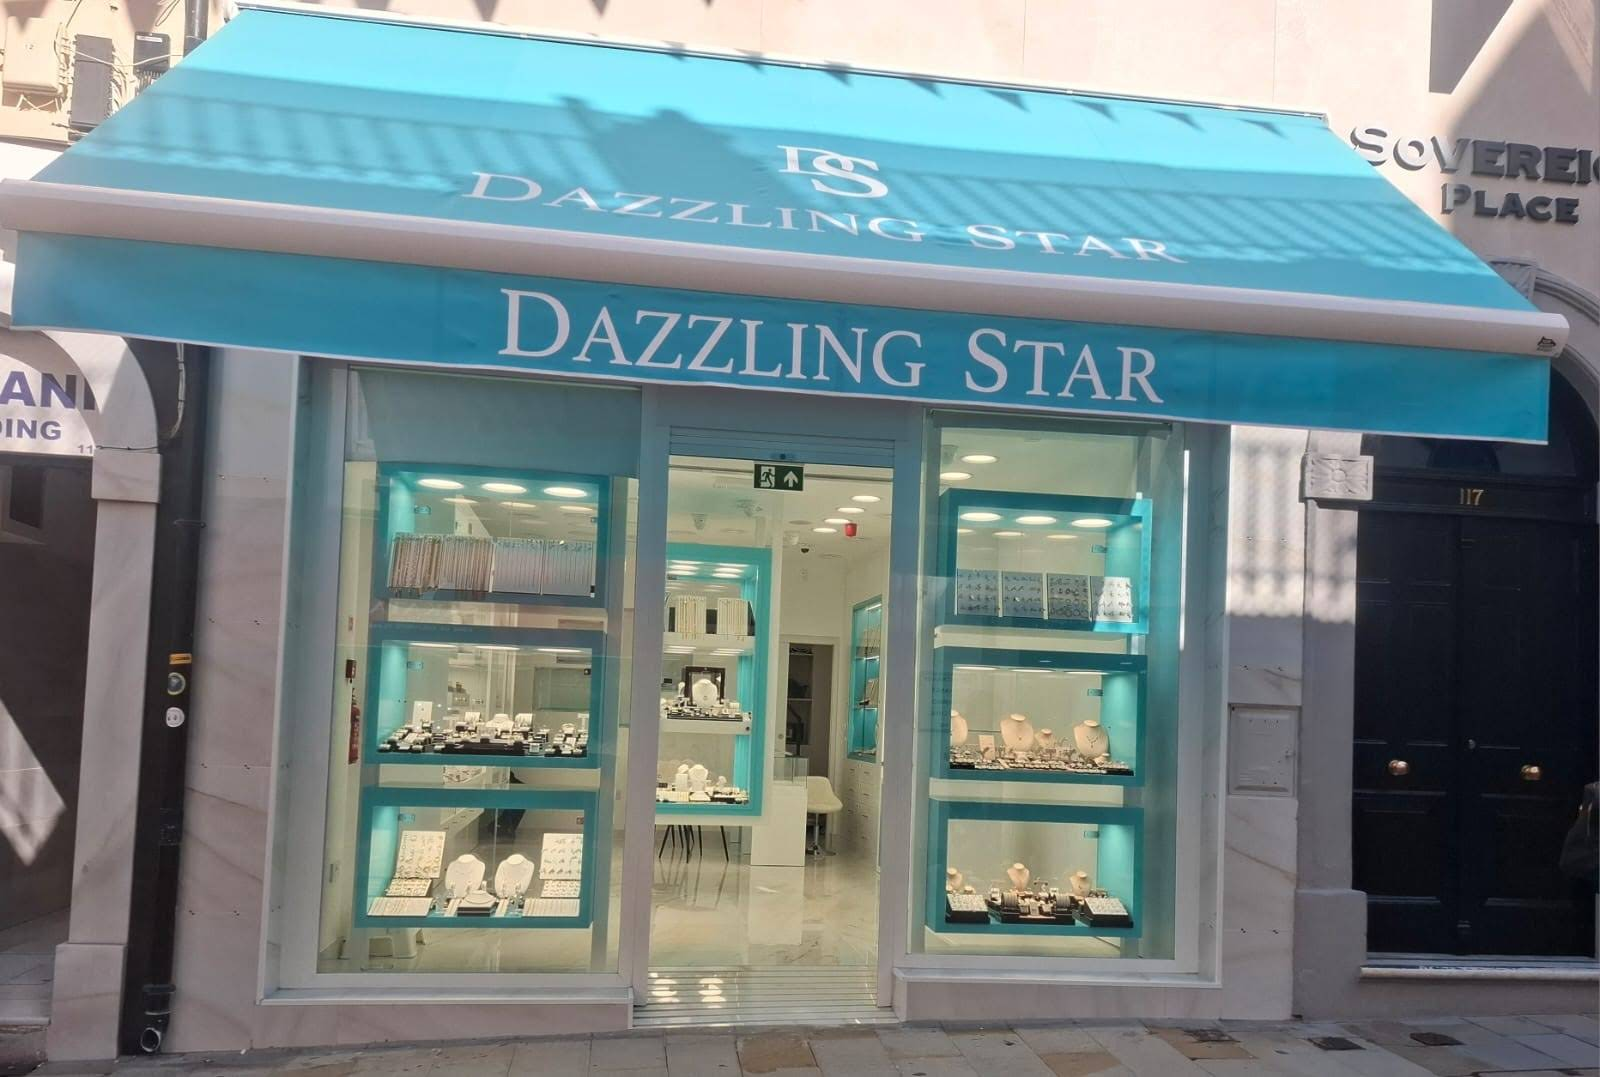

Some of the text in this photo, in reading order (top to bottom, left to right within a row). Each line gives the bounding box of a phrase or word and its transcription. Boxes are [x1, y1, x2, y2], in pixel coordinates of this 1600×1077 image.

[1350, 127, 1600, 184] SOVEREI
[461, 171, 1189, 264] DAZZLING STAR
[1441, 182, 1580, 224] PLACE
[498, 288, 1165, 405] DAZZLING STAR
[0, 418, 62, 441] ING
[1459, 487, 1485, 506] 117
